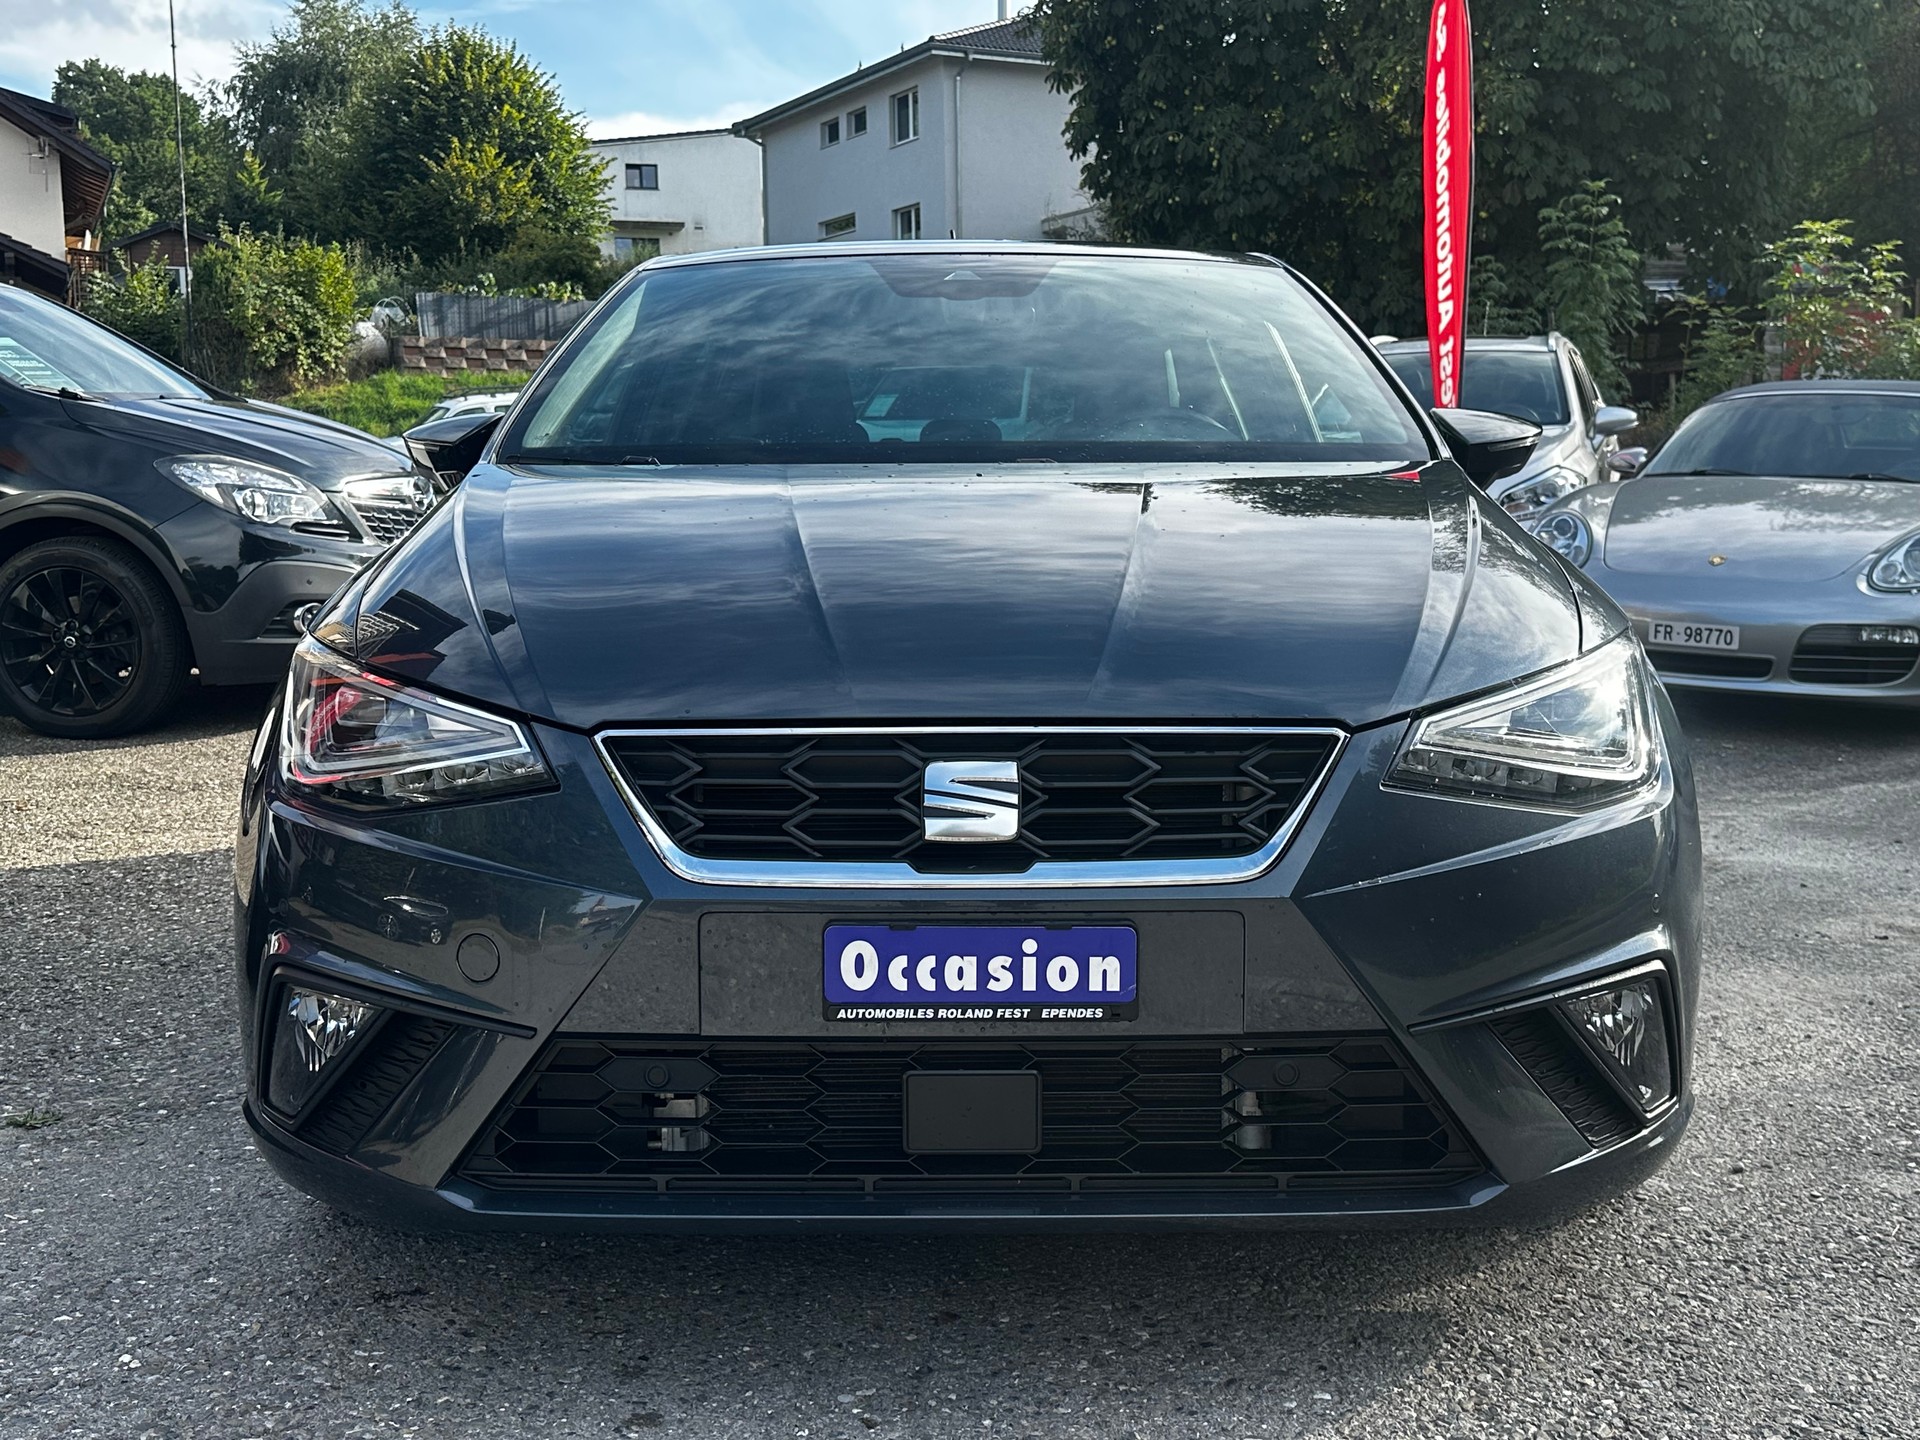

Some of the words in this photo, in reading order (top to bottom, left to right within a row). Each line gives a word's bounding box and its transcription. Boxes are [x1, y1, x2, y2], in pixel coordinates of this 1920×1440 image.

[840, 938, 1121, 992] Occasion
[836, 1008, 934, 1019] AUTOMOBILES
[937, 1008, 994, 1019] ROLAND
[996, 1008, 1031, 1019] FEST
[1041, 1008, 1104, 1019] EPENDES
